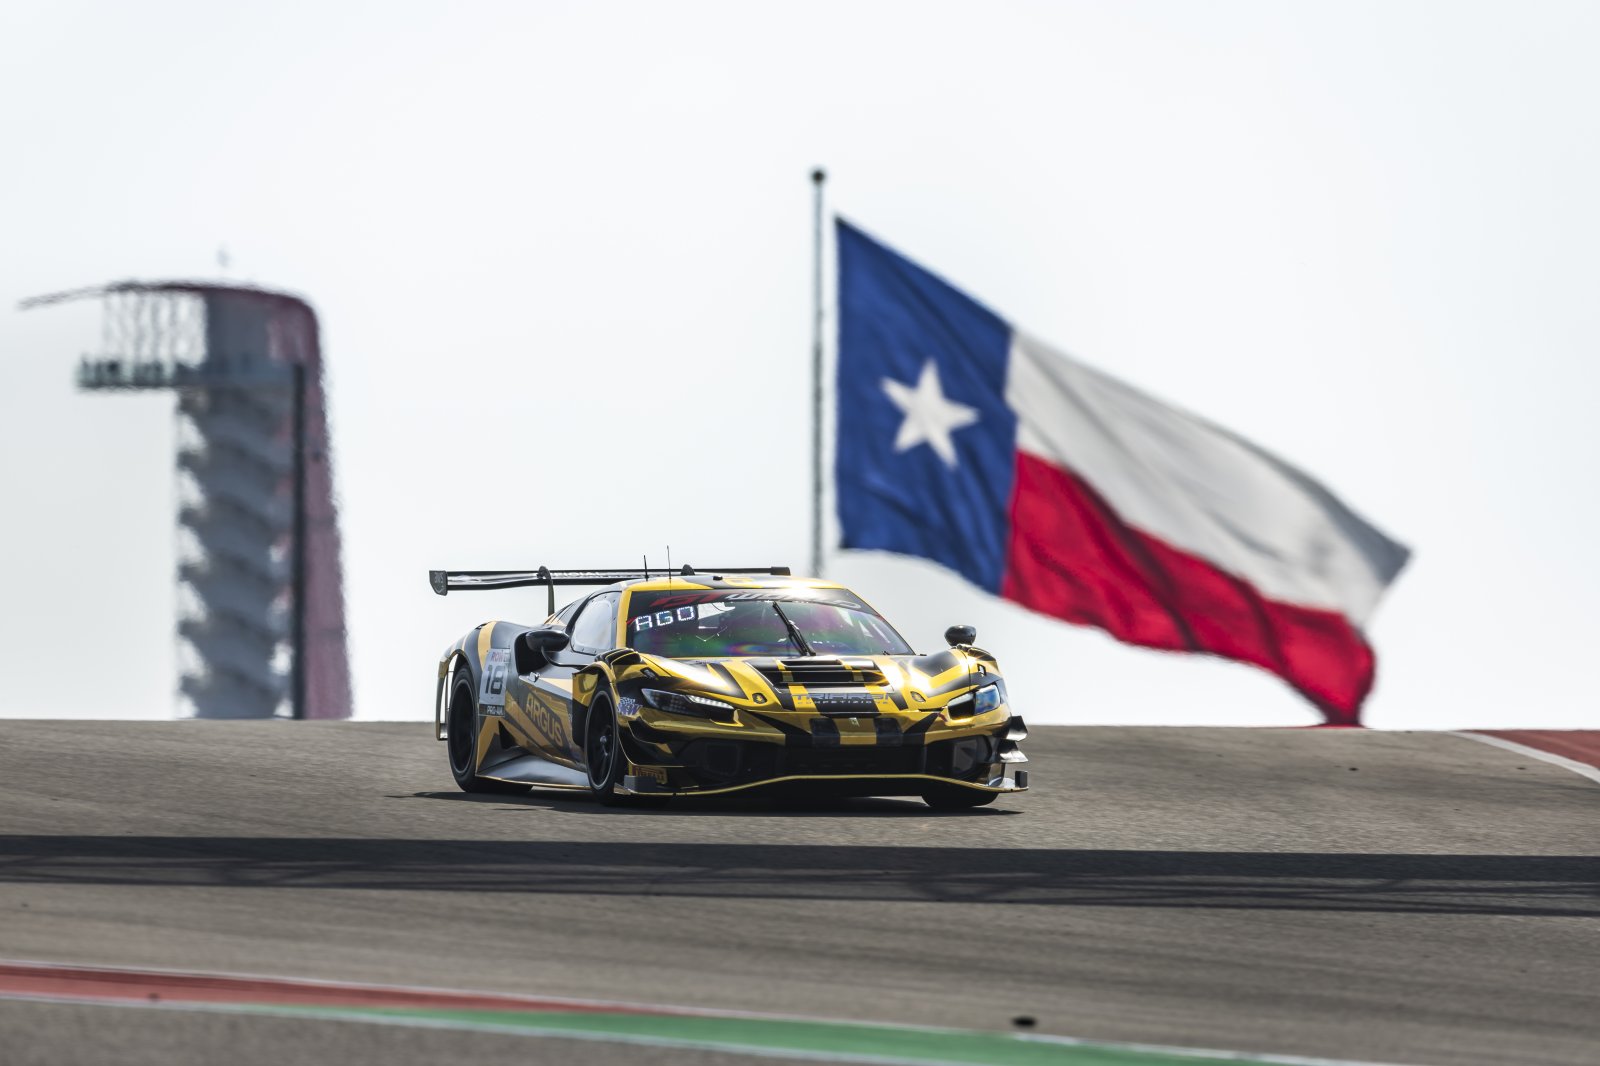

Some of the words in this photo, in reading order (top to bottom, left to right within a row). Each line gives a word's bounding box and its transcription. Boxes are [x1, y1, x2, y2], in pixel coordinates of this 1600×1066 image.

[726, 592, 861, 610] WORD
[635, 606, 695, 631] AGO
[791, 692, 889, 700] TRIARSI
[525, 693, 563, 747] ARGUS
